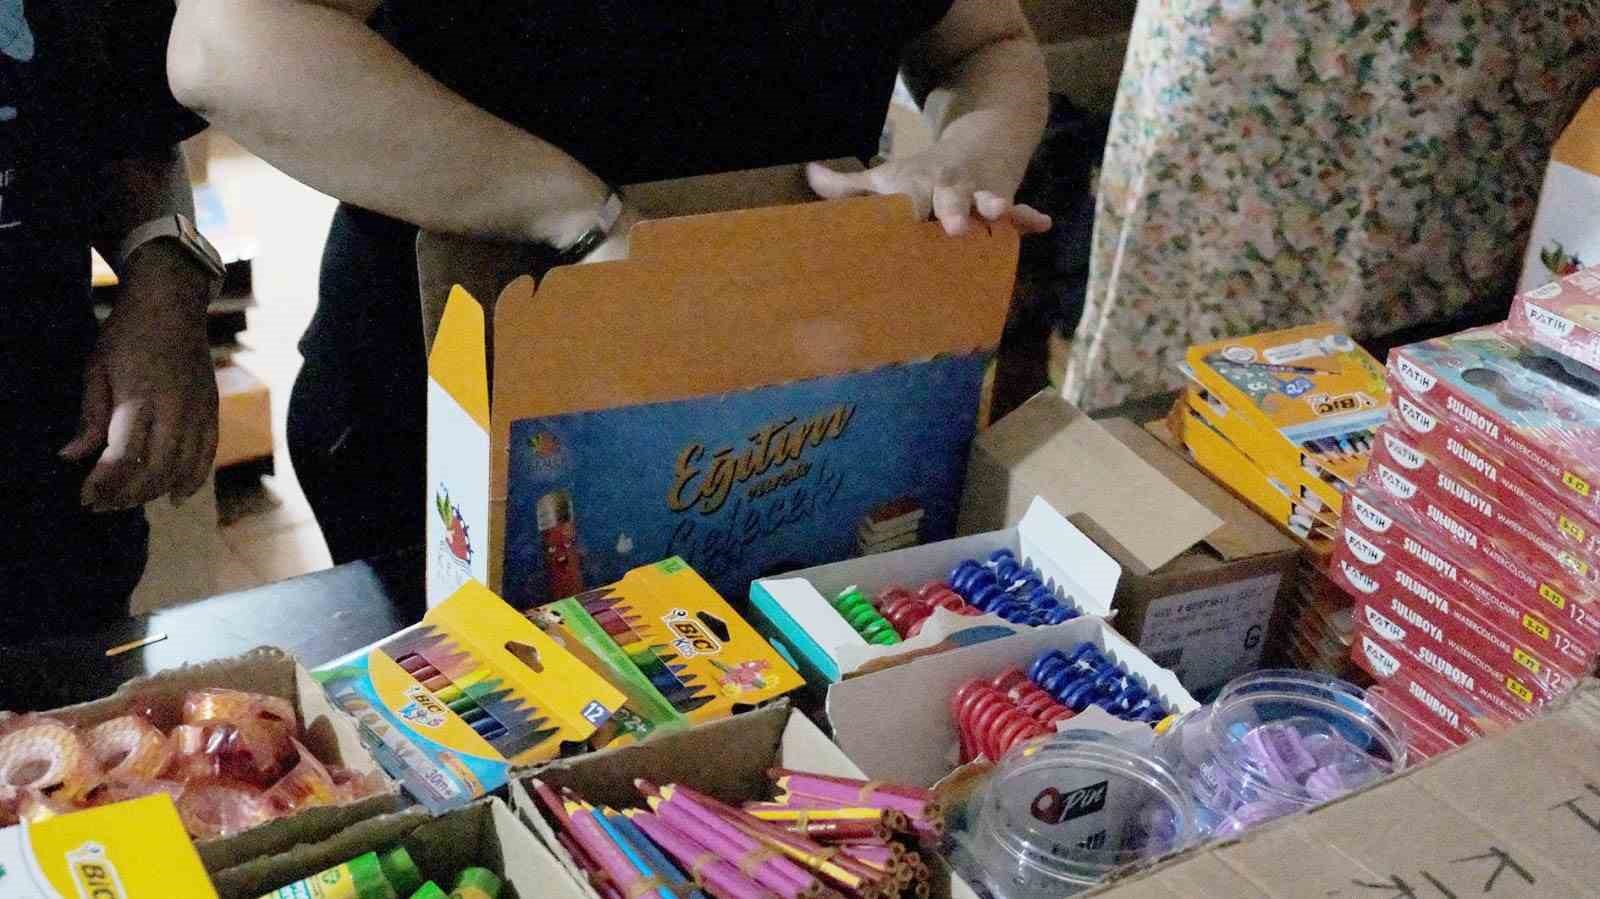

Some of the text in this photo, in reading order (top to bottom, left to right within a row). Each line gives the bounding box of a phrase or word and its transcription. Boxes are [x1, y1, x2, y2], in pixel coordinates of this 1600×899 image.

[1319, 397, 1355, 413] BIC
[1446, 395, 1499, 440] SULUBOYA
[1446, 437, 1497, 481] SULUBOYA
[1438, 473, 1493, 518] SULUBOYA
[1404, 537, 1457, 581] SULUBOYA
[1554, 633, 1570, 654] 12
[1569, 603, 1585, 624] 12
[674, 622, 713, 650] BIC
[1391, 598, 1443, 643] SULUBOYA
[1395, 570, 1449, 615] SULUBOYA
[1544, 667, 1560, 688] 12
[1418, 646, 1475, 691] SULUBOYA
[415, 694, 442, 713] BIC
[582, 701, 602, 723] 12
[1409, 680, 1459, 728] SULUBOYA
